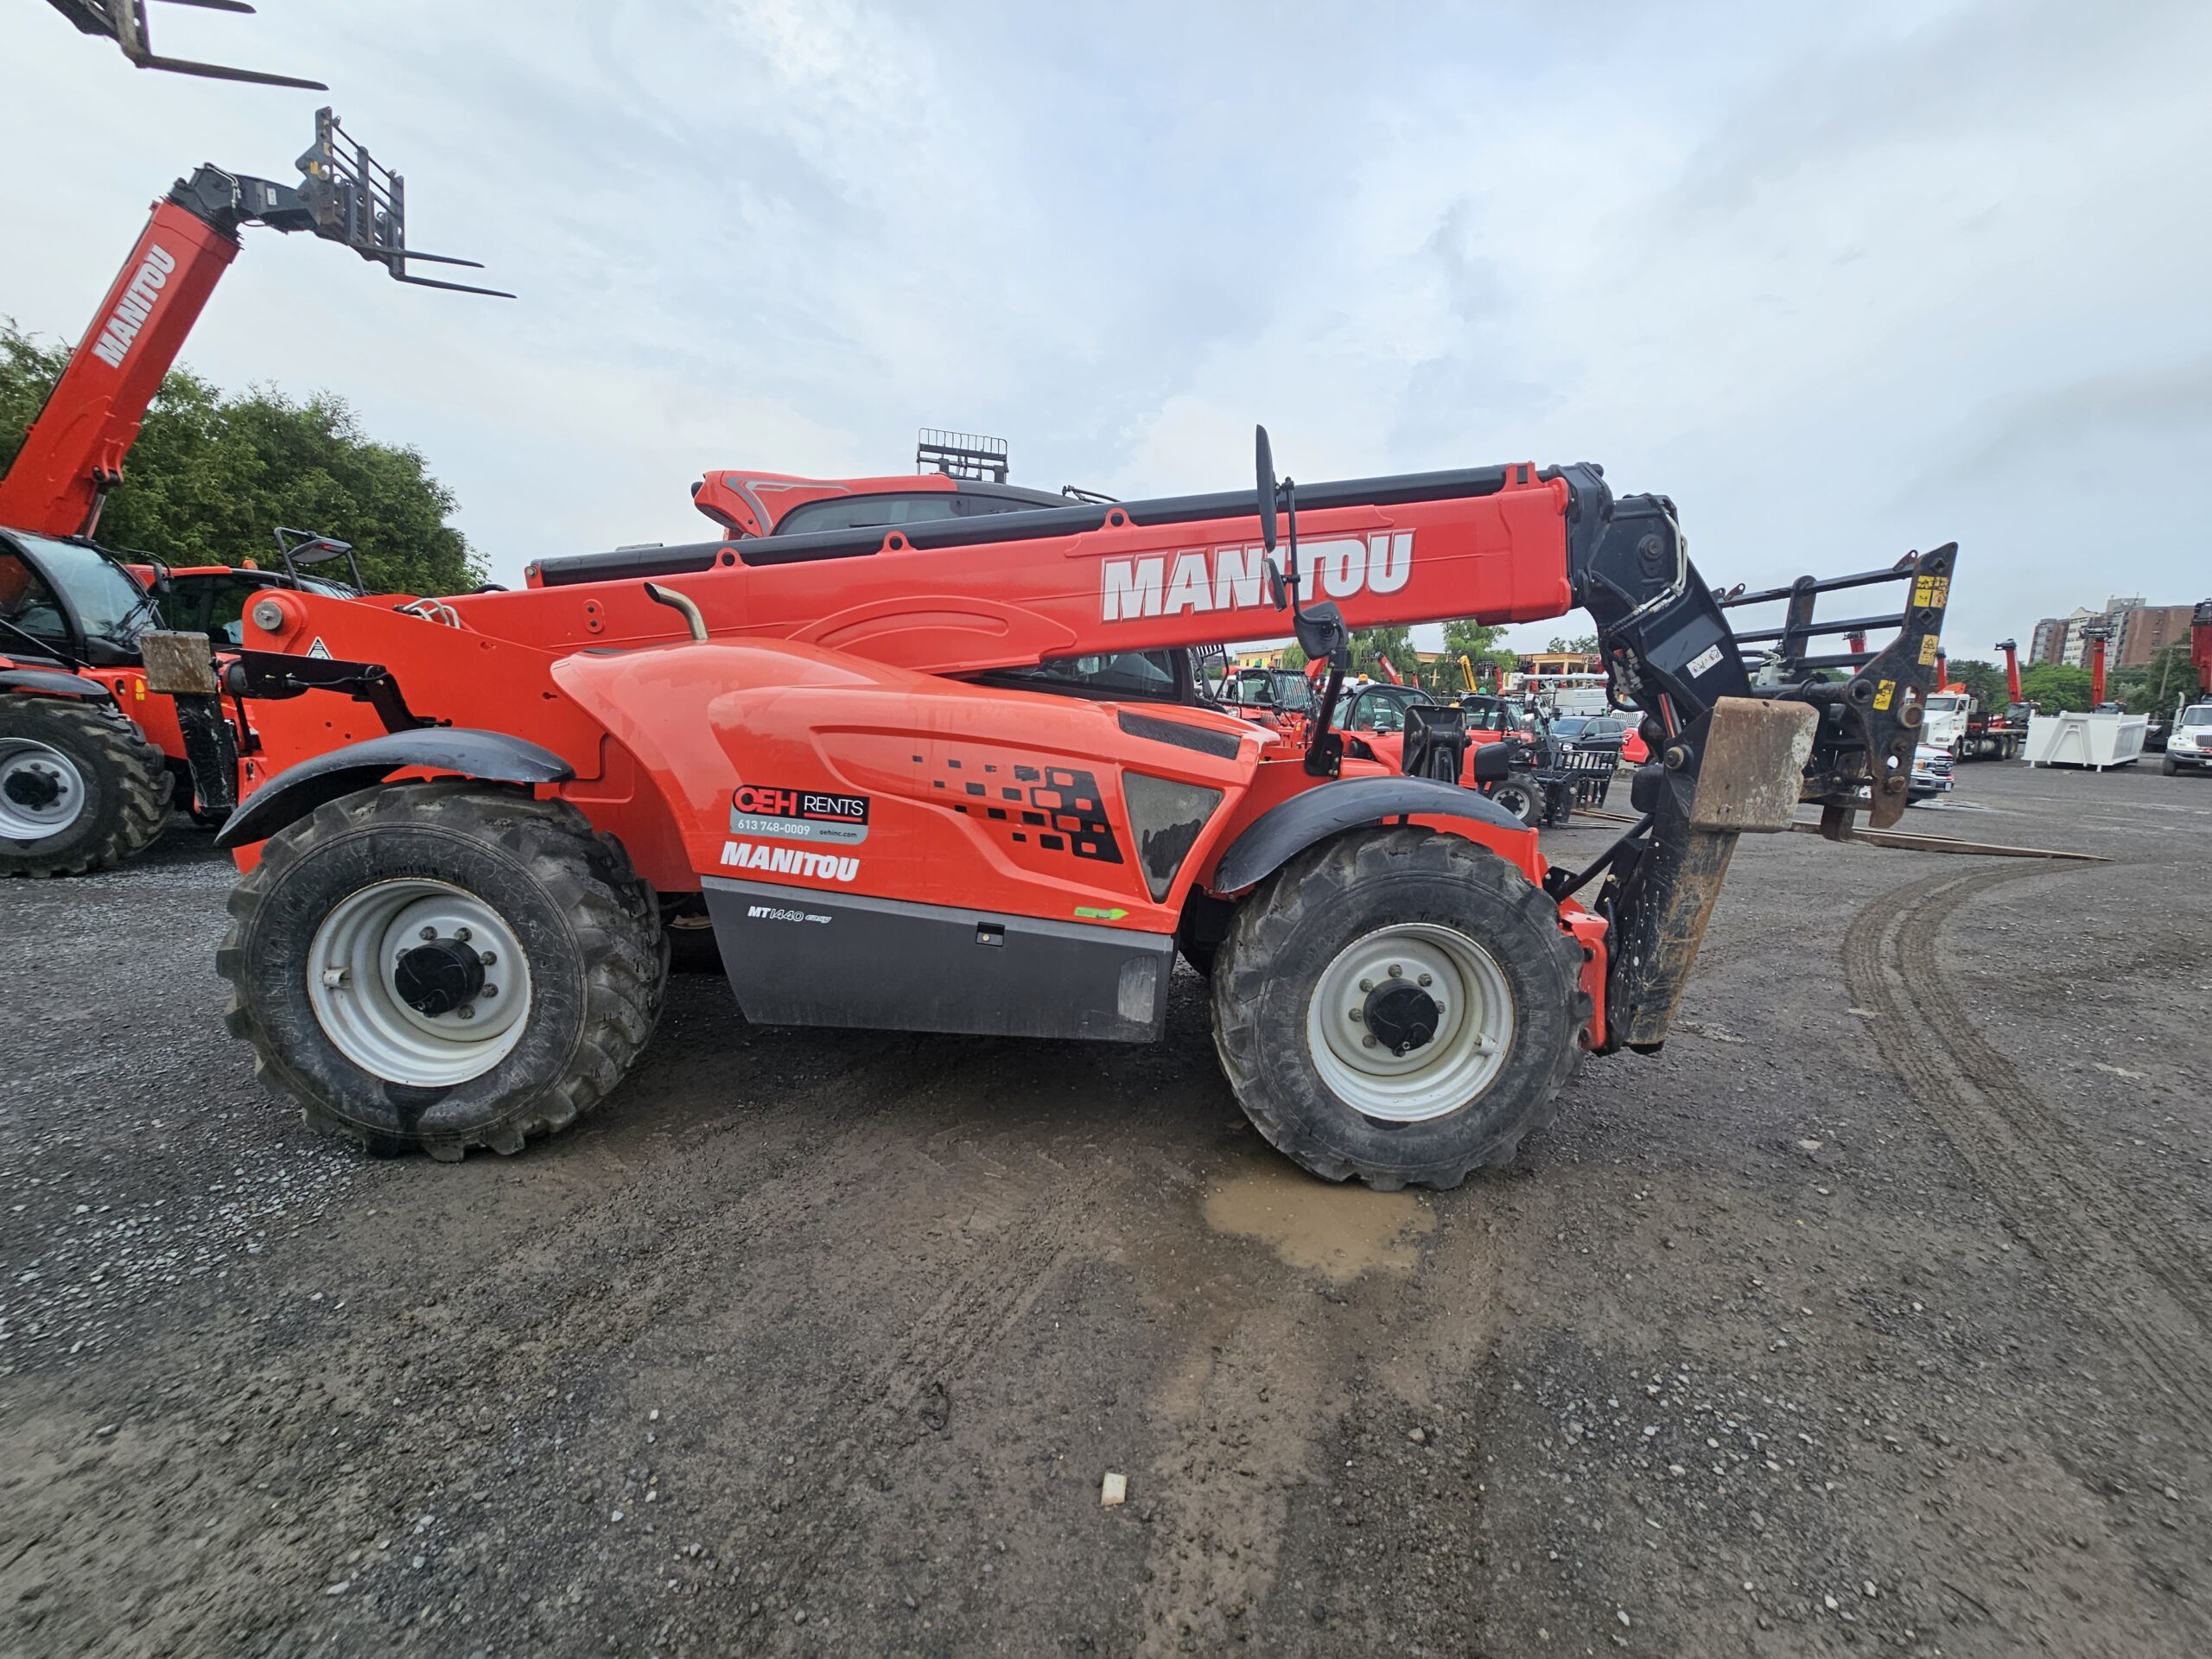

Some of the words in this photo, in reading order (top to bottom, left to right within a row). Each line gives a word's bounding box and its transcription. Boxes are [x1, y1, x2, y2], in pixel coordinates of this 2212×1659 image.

[92, 243, 176, 369] MANITOU
[734, 787, 798, 816] OEH
[804, 795, 864, 816] RENTS
[738, 819, 758, 830] 613
[760, 821, 810, 835] 748-0009
[819, 830, 858, 838] oehinc.com
[720, 841, 860, 882] MANITOU
